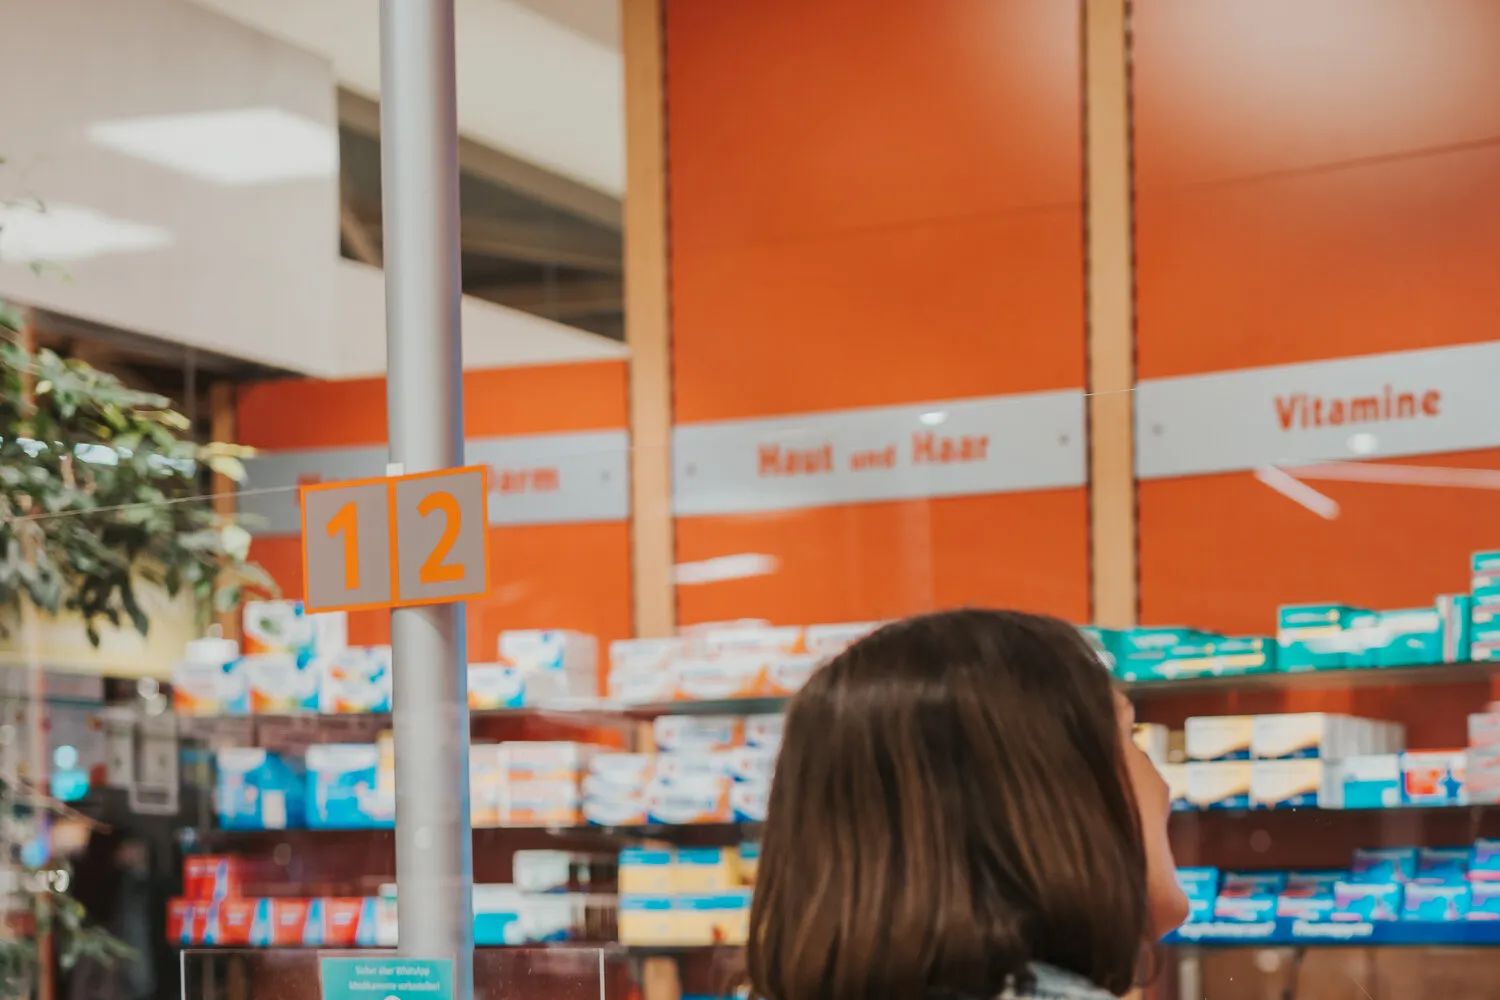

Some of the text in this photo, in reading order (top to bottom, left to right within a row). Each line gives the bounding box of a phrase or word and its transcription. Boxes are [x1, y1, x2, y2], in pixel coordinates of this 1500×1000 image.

[1273, 384, 1442, 431] Vitamine
[757, 430, 990, 477] Haut und Haar
